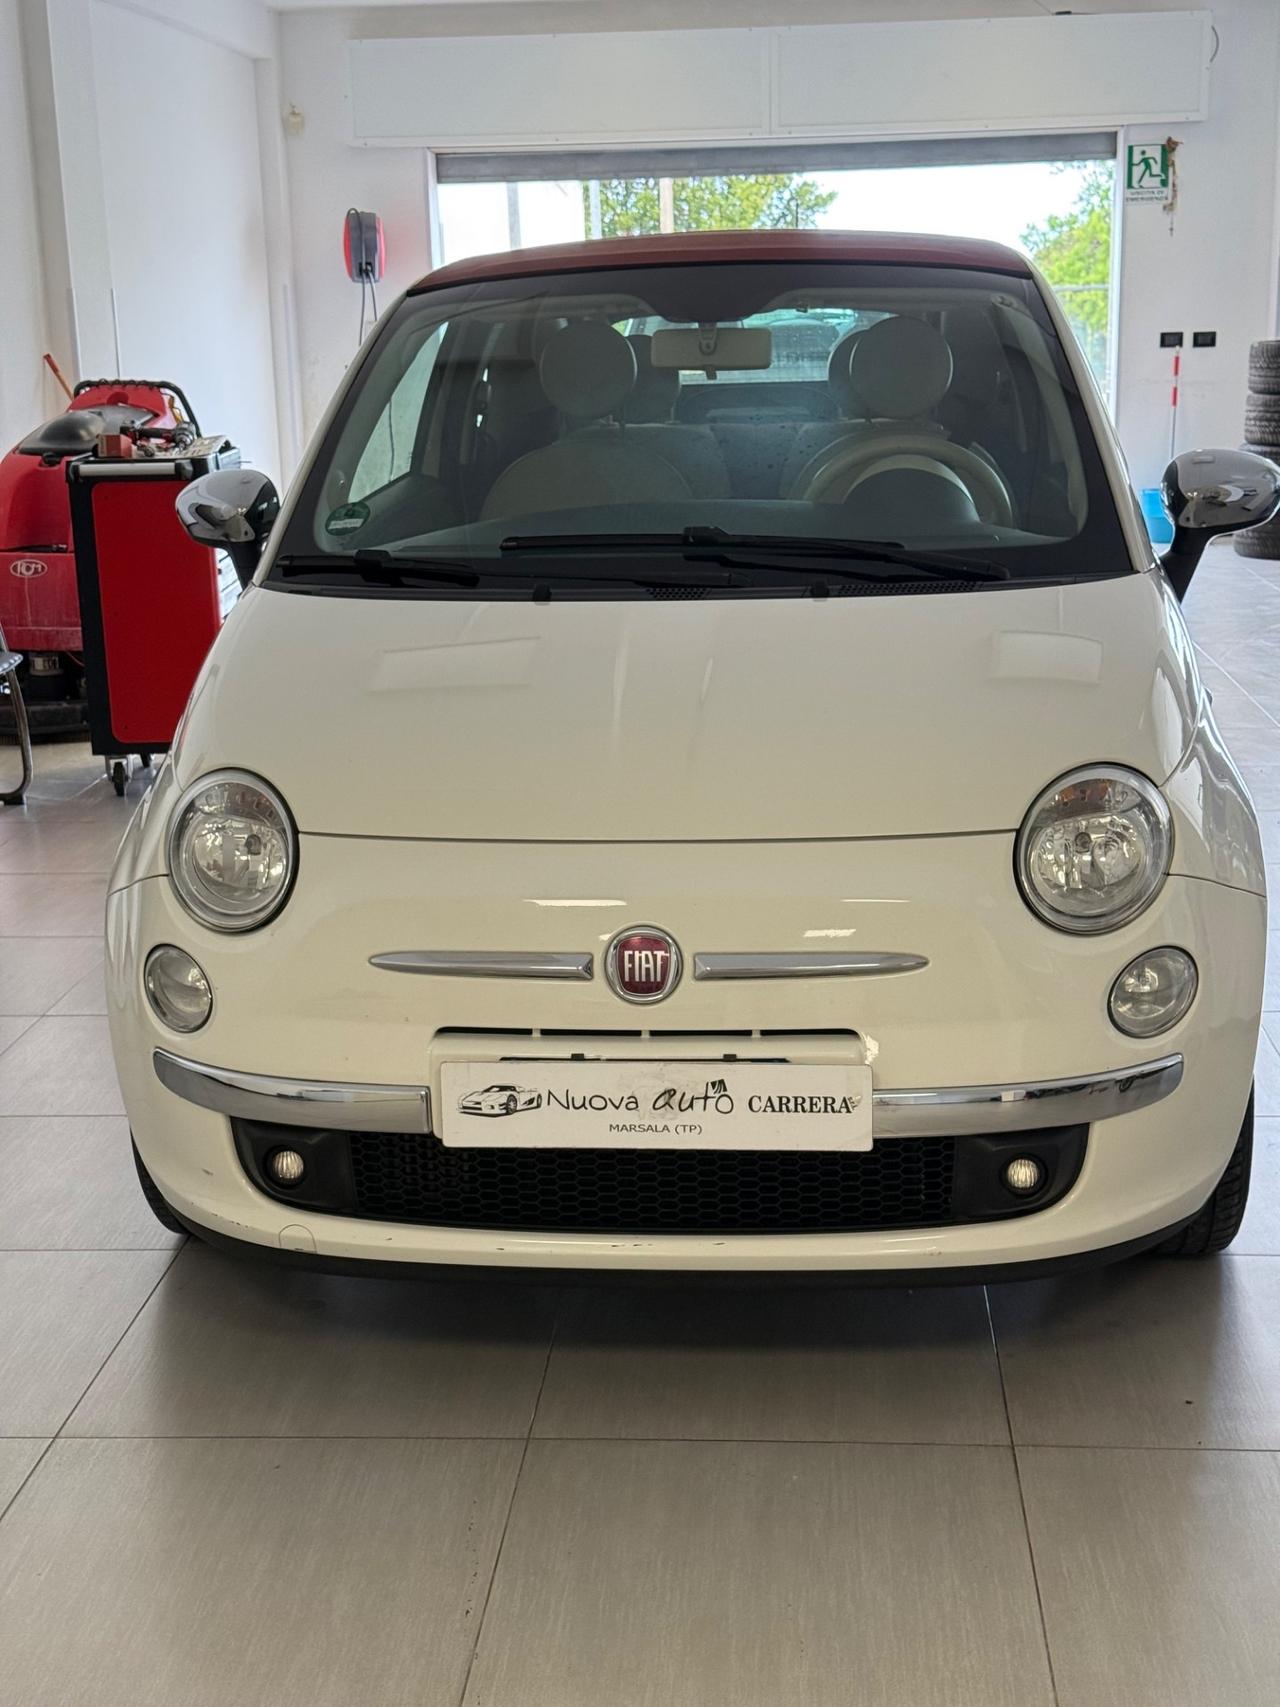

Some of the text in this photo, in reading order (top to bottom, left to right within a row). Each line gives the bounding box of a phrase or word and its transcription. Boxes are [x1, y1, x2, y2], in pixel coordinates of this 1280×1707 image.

[623, 950, 669, 983] FIAT
[547, 1089, 640, 1111] Nuova
[748, 1095, 853, 1114] CARRERA
[609, 1124, 703, 1136] MARSALA (TP)
